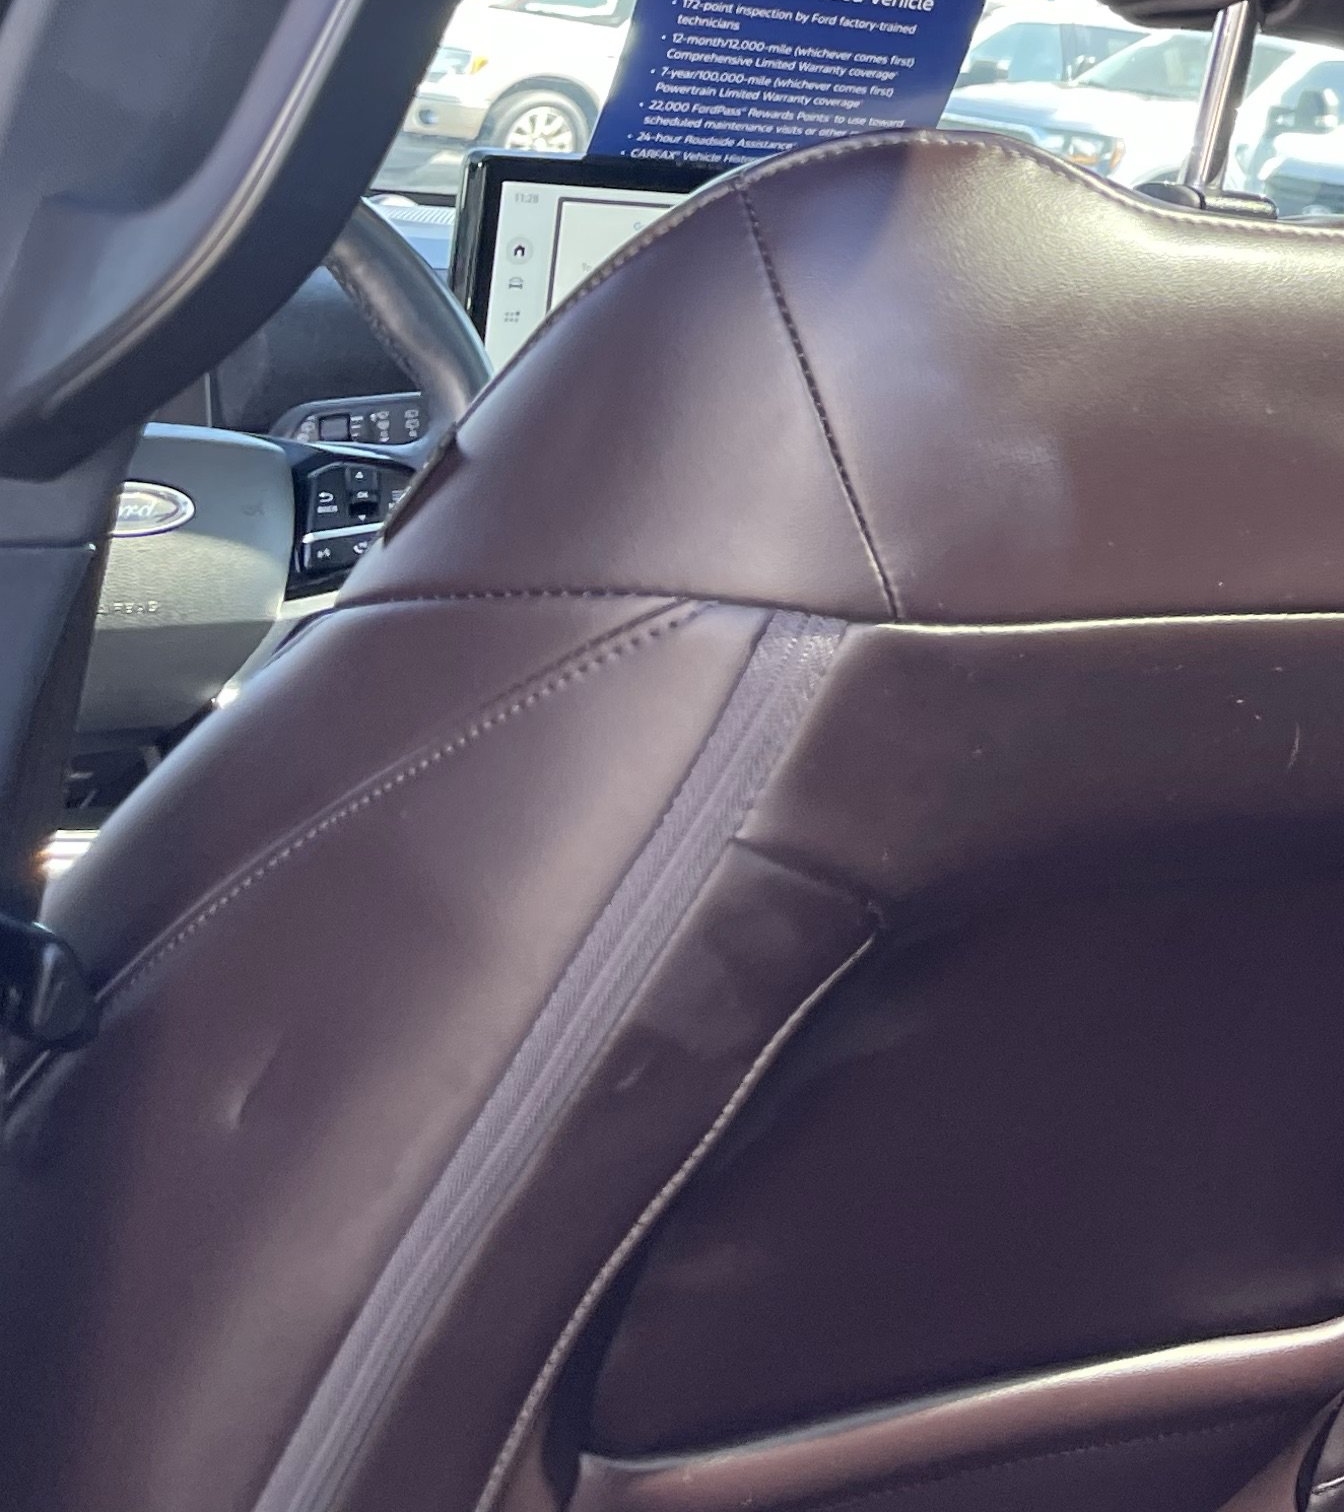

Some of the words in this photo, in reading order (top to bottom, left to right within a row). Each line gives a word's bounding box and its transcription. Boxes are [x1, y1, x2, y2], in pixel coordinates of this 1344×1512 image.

[677, 14, 740, 31] technicians
[735, 4, 793, 21] inspection
[795, 10, 810, 25] by
[811, 13, 838, 26] Ford
[839, 16, 918, 35] factory-trained
[666, 48, 754, 67] Comprehensive
[755, 57, 797, 72] Limited
[798, 61, 848, 78] Warranty
[793, 46, 852, 62] (whichever
[853, 52, 888, 66] comes
[890, 55, 916, 69] first)
[655, 81, 718, 98] Powertrain
[719, 87, 761, 101] Limited
[762, 91, 812, 106] Warranty
[773, 76, 832, 91] (whichever
[832, 84, 868, 95] comes
[869, 85, 895, 98] first)
[643, 115, 703, 129] scheduled
[703, 119, 774, 134] maintenance
[775, 124, 803, 136] visits
[804, 126, 817, 136] or
[818, 127, 848, 137] other
[747, 107, 794, 121] Rewards
[833, 114, 846, 125] to
[847, 117, 867, 127] use
[868, 117, 906, 128] toward
[636, 131, 683, 145] 24-hour
[683, 134, 736, 148] Roadside
[682, 150, 722, 164] Vehicle
